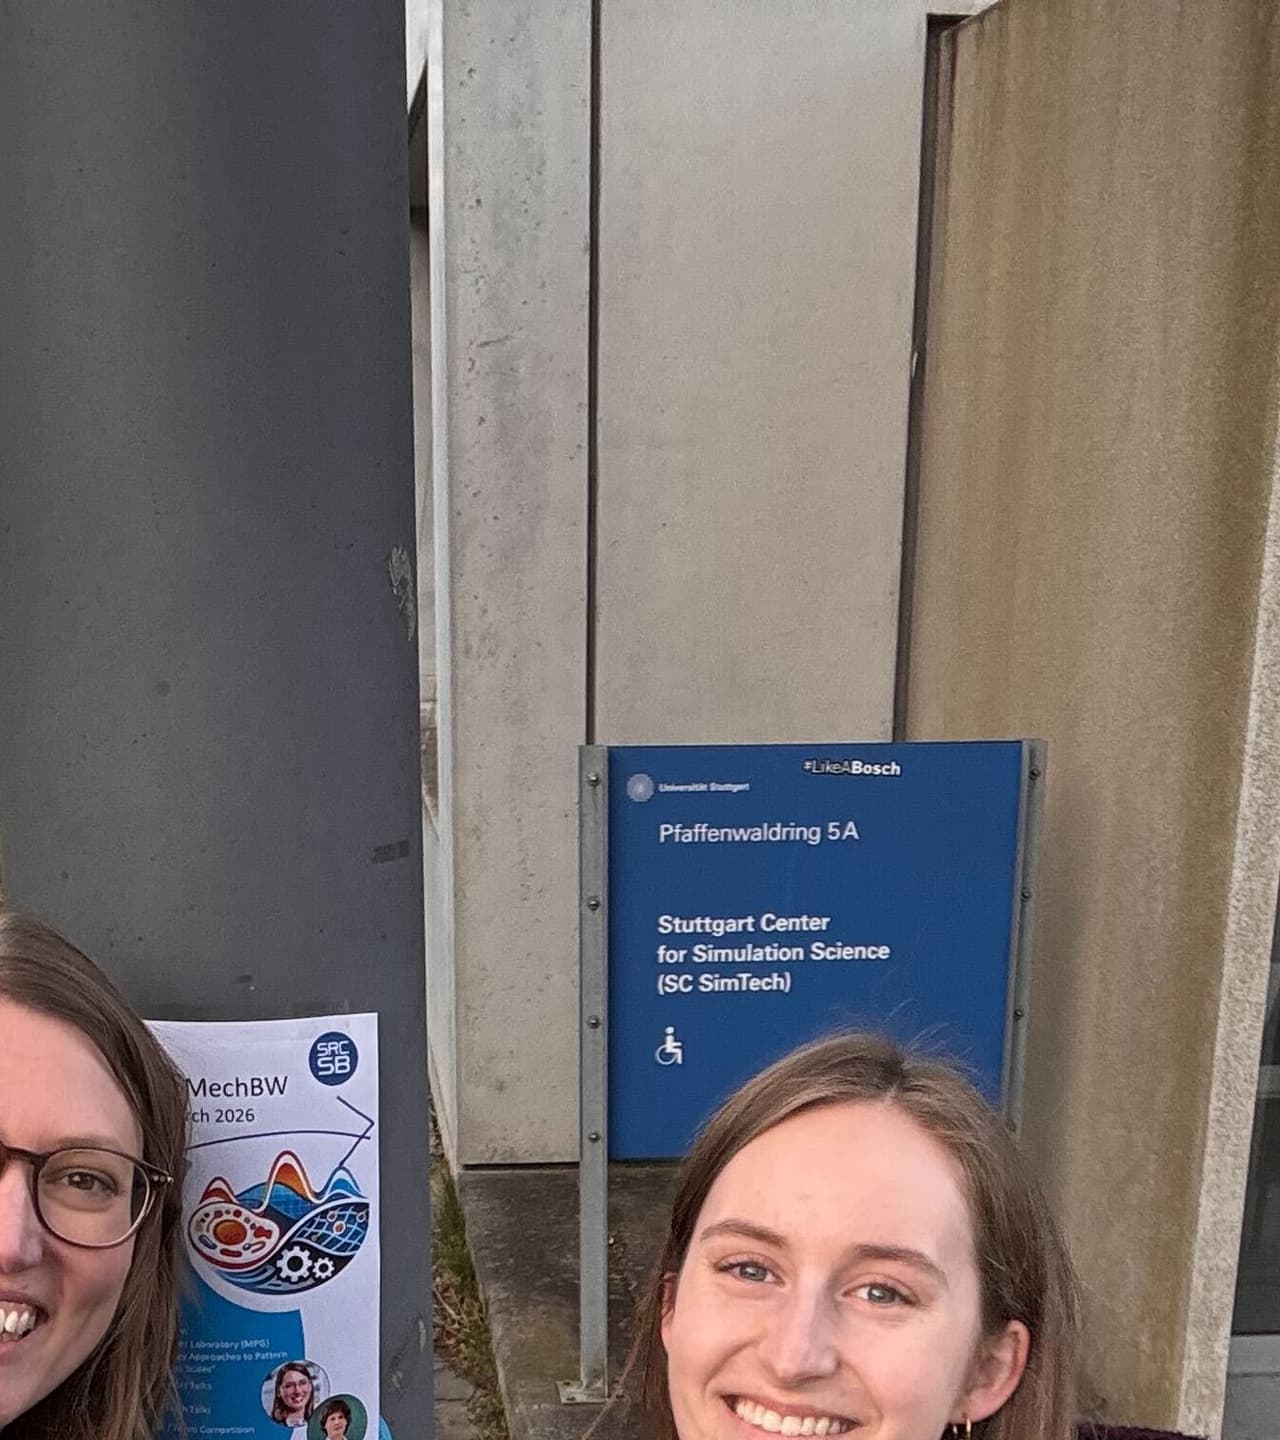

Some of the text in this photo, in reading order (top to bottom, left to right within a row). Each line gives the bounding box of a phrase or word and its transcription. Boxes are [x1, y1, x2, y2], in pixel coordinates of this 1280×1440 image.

[659, 822, 821, 845] Pfaffenwaldring
[657, 913, 831, 936] Stuttgart Center
[657, 942, 891, 963] for Simulation Science
[657, 972, 792, 995] (SC SimTech)
[316, 1040, 350, 1057] SRC
[317, 1055, 350, 1076] SB
[215, 1108, 256, 1123] 2026
